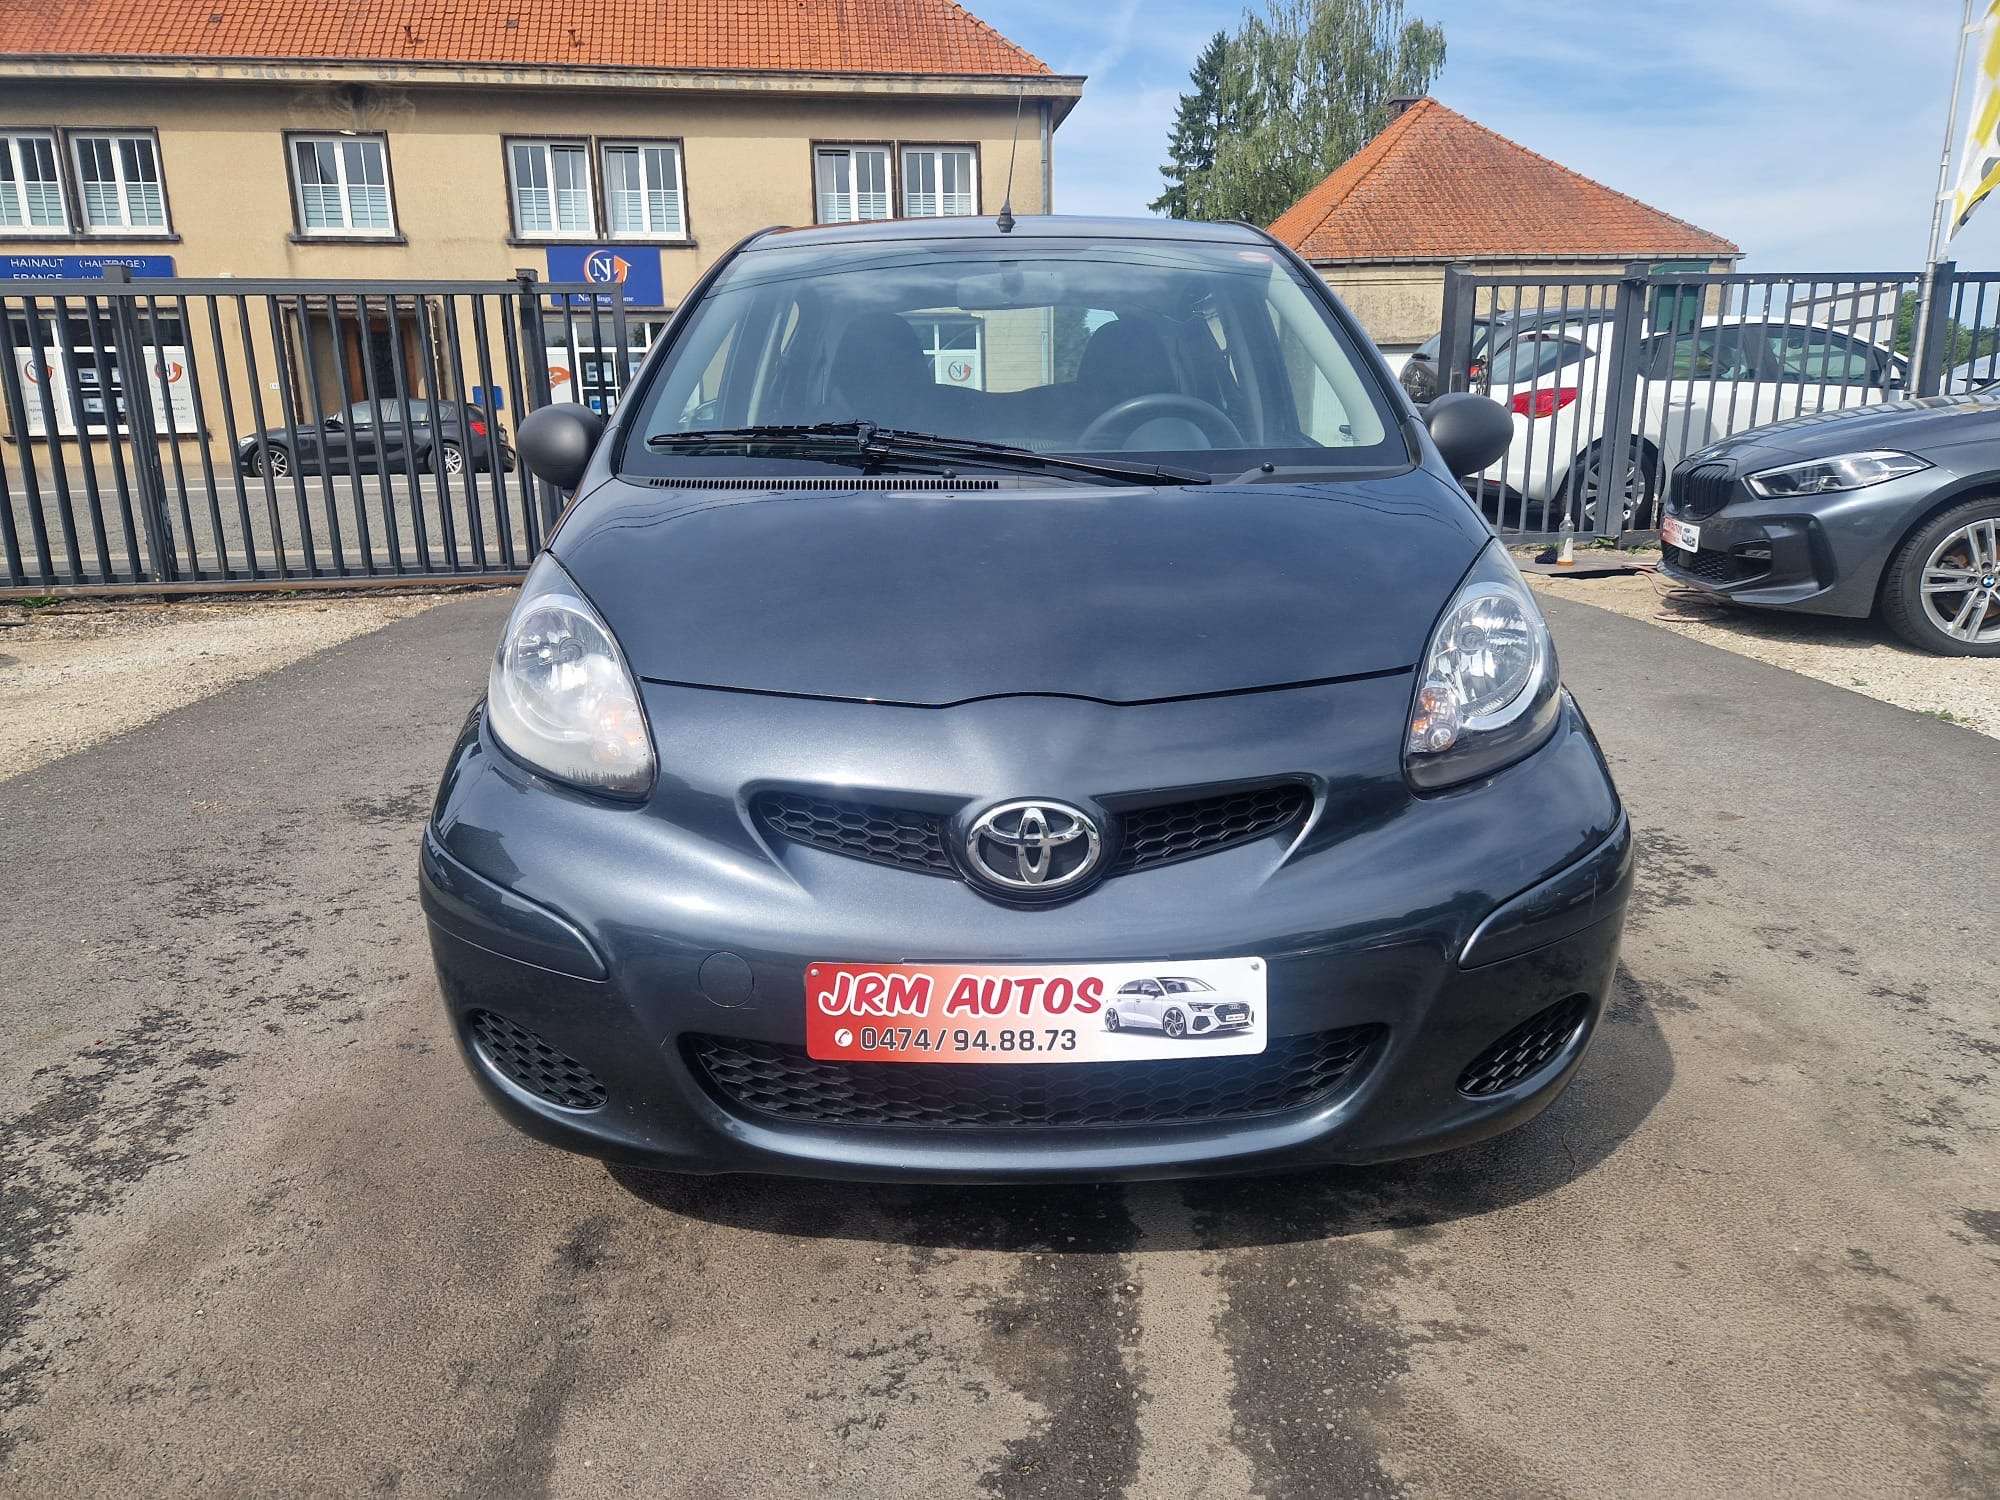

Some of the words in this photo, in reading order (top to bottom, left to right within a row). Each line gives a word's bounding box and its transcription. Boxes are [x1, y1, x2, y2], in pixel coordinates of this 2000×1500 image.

[10, 258, 64, 268] HAINAUT
[820, 973, 933, 1016] JRM
[945, 975, 1105, 1017] AUTOS
